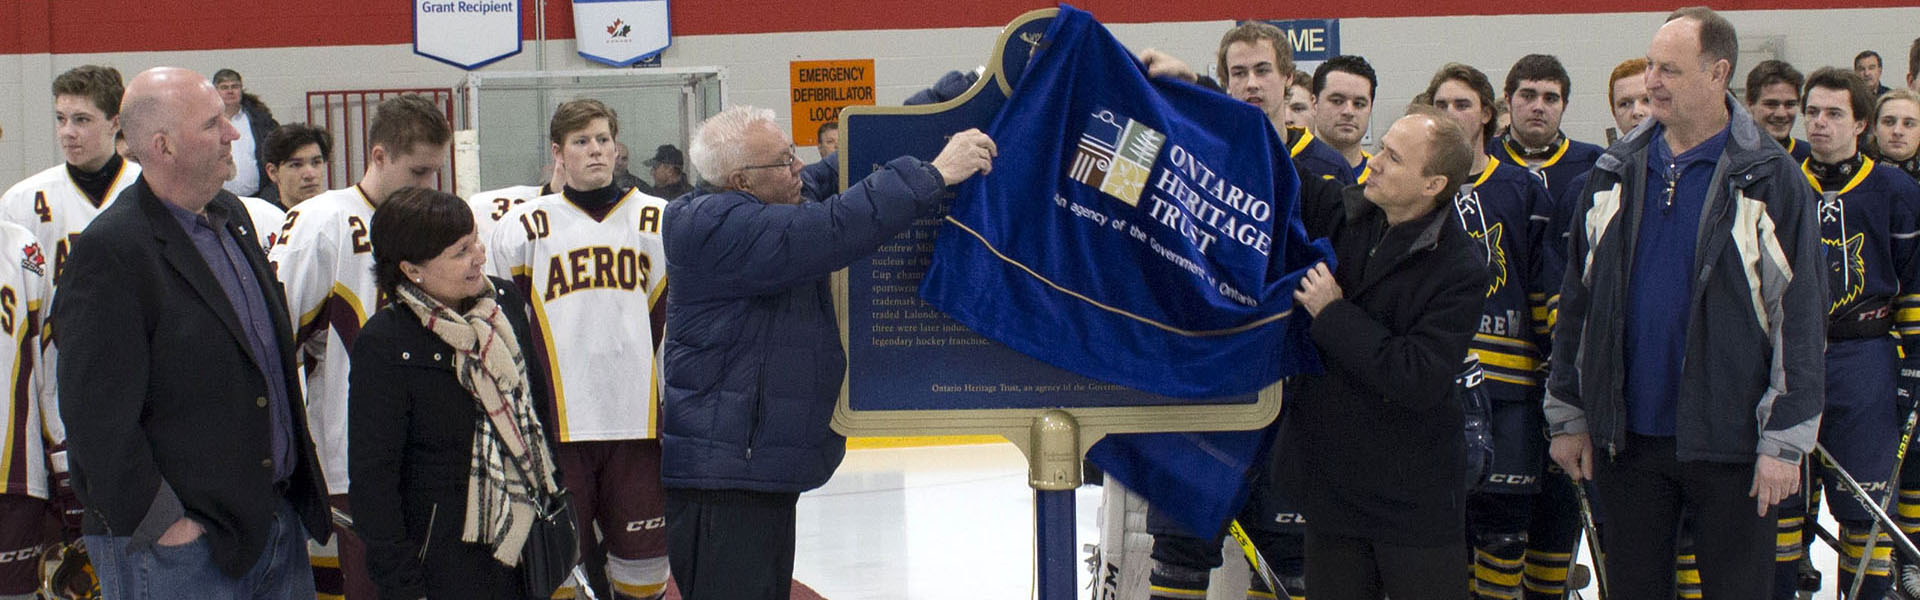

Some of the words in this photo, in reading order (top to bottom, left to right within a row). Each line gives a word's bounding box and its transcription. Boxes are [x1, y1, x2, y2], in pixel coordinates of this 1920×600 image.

[422, 1, 455, 13] Grant
[458, 1, 513, 15] Recipient
[799, 67, 865, 83] EMERGENCY
[793, 86, 873, 102] DEFIBRILLATOR
[1168, 144, 1271, 223] ONTARIO
[34, 190, 52, 223] 4
[1153, 167, 1272, 256] HERITAGE
[519, 209, 550, 241] 10
[638, 204, 661, 235] A
[1149, 194, 1217, 255] TRUST
[1053, 193, 1068, 208] An
[1070, 202, 1108, 227] agency
[1111, 219, 1127, 231] of
[1129, 225, 1147, 242] the
[1219, 282, 1258, 307] Ontario
[872, 256, 905, 266] nucleus
[543, 246, 653, 302] AEROS
[872, 270, 892, 281] Cup
[872, 297, 916, 307] trademark
[872, 310, 900, 320] traded
[904, 310, 939, 320] Lalonde
[872, 323, 895, 333] three
[897, 324, 918, 333] were
[920, 323, 941, 333] later
[872, 336, 914, 347] legendary
[916, 336, 946, 347] hockey
[932, 383, 962, 393] Ontario
[964, 384, 997, 394] Heritage
[1000, 384, 1021, 393] Trust,
[1035, 385, 1061, 393] agency
[1490, 473, 1537, 485] CCM
